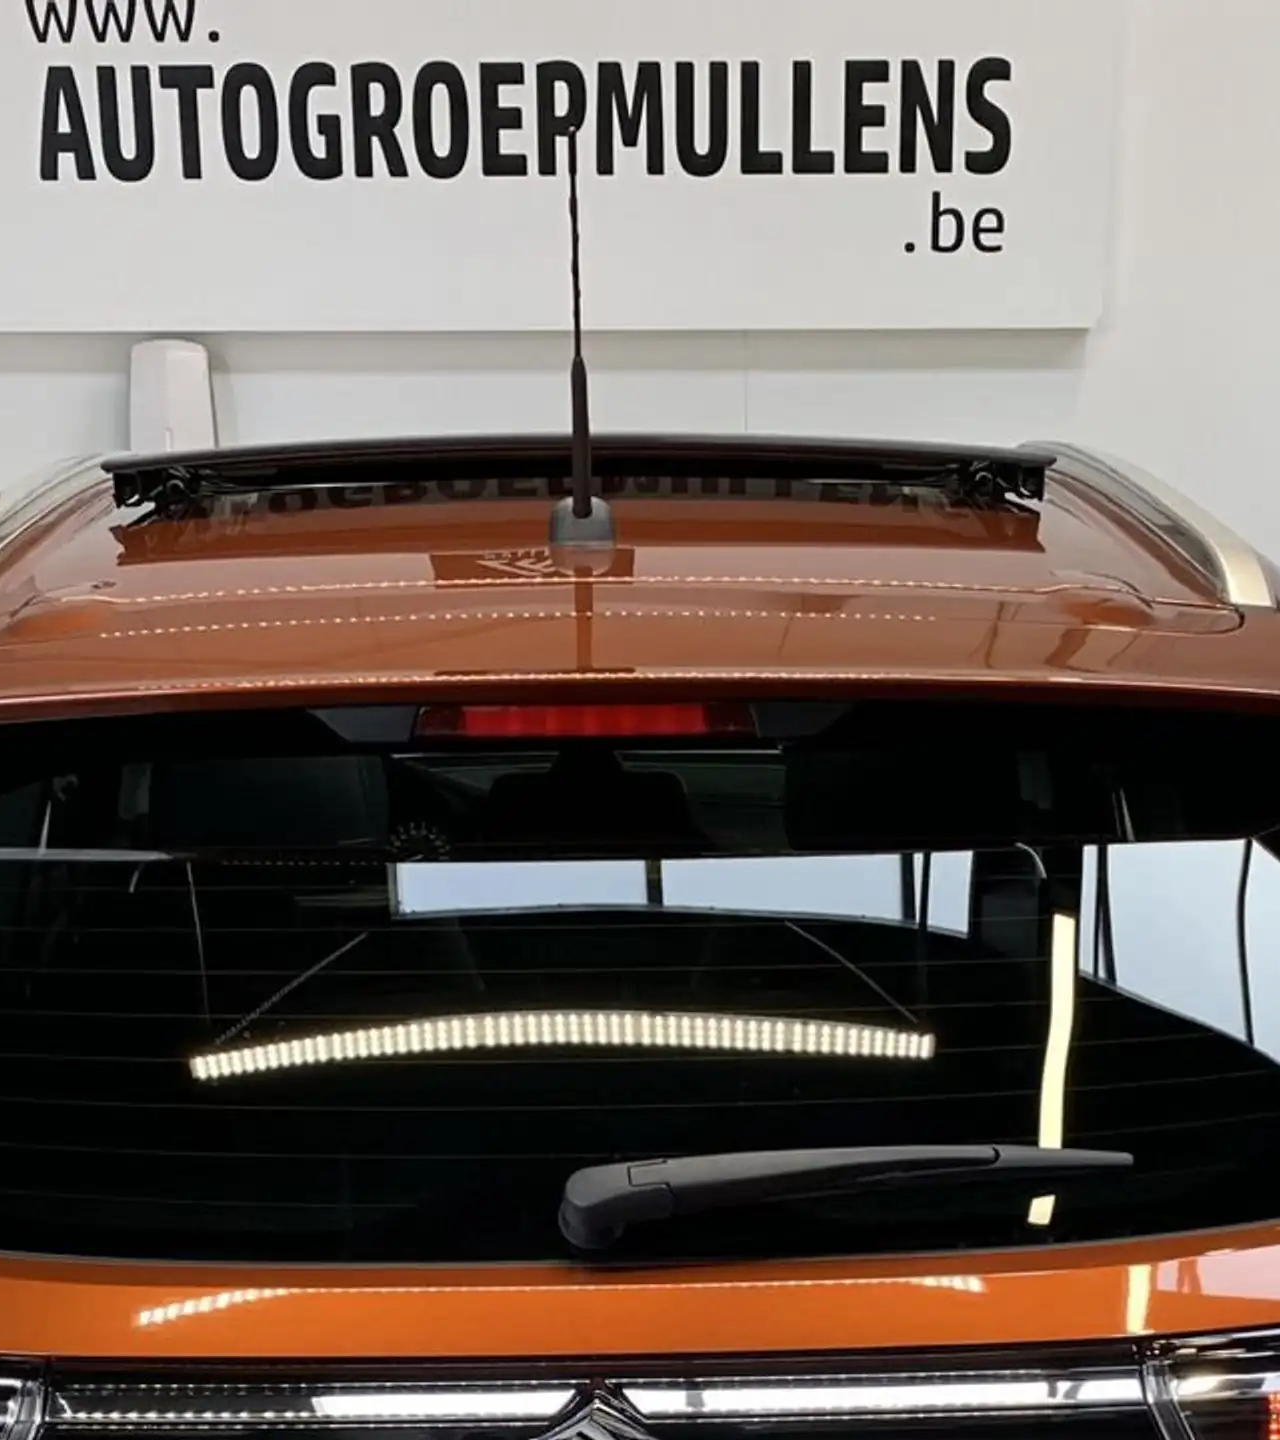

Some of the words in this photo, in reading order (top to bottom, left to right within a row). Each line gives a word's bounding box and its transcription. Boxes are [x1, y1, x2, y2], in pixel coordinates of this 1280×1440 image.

[25, 0, 220, 43] www.
[39, 57, 1012, 182] AUTOGROEPMULLENS
[904, 190, 1005, 254] .be
